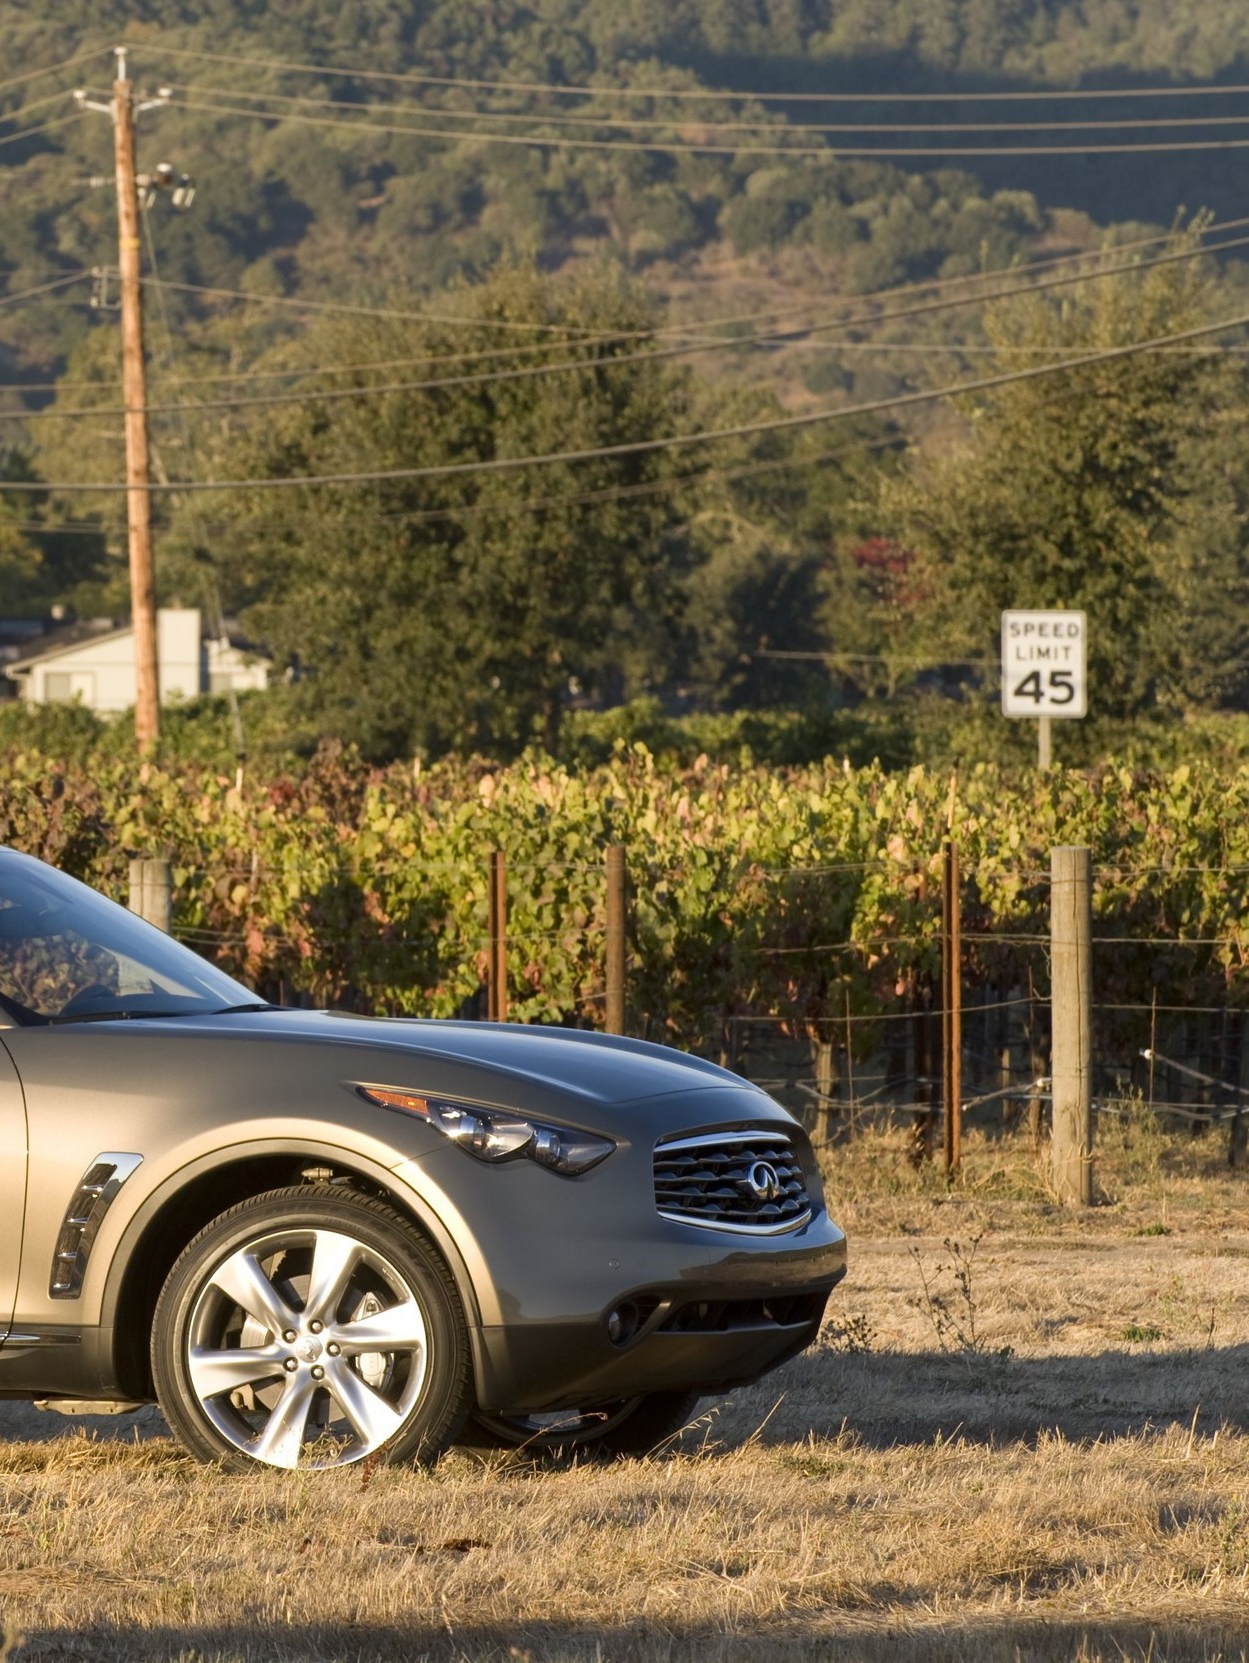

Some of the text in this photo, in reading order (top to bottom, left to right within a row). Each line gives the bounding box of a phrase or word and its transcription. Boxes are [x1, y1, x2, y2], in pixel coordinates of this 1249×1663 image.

[1010, 622, 1079, 638] SPEED
[1015, 645, 1072, 660] LIMIT
[1013, 670, 1075, 704] 45
